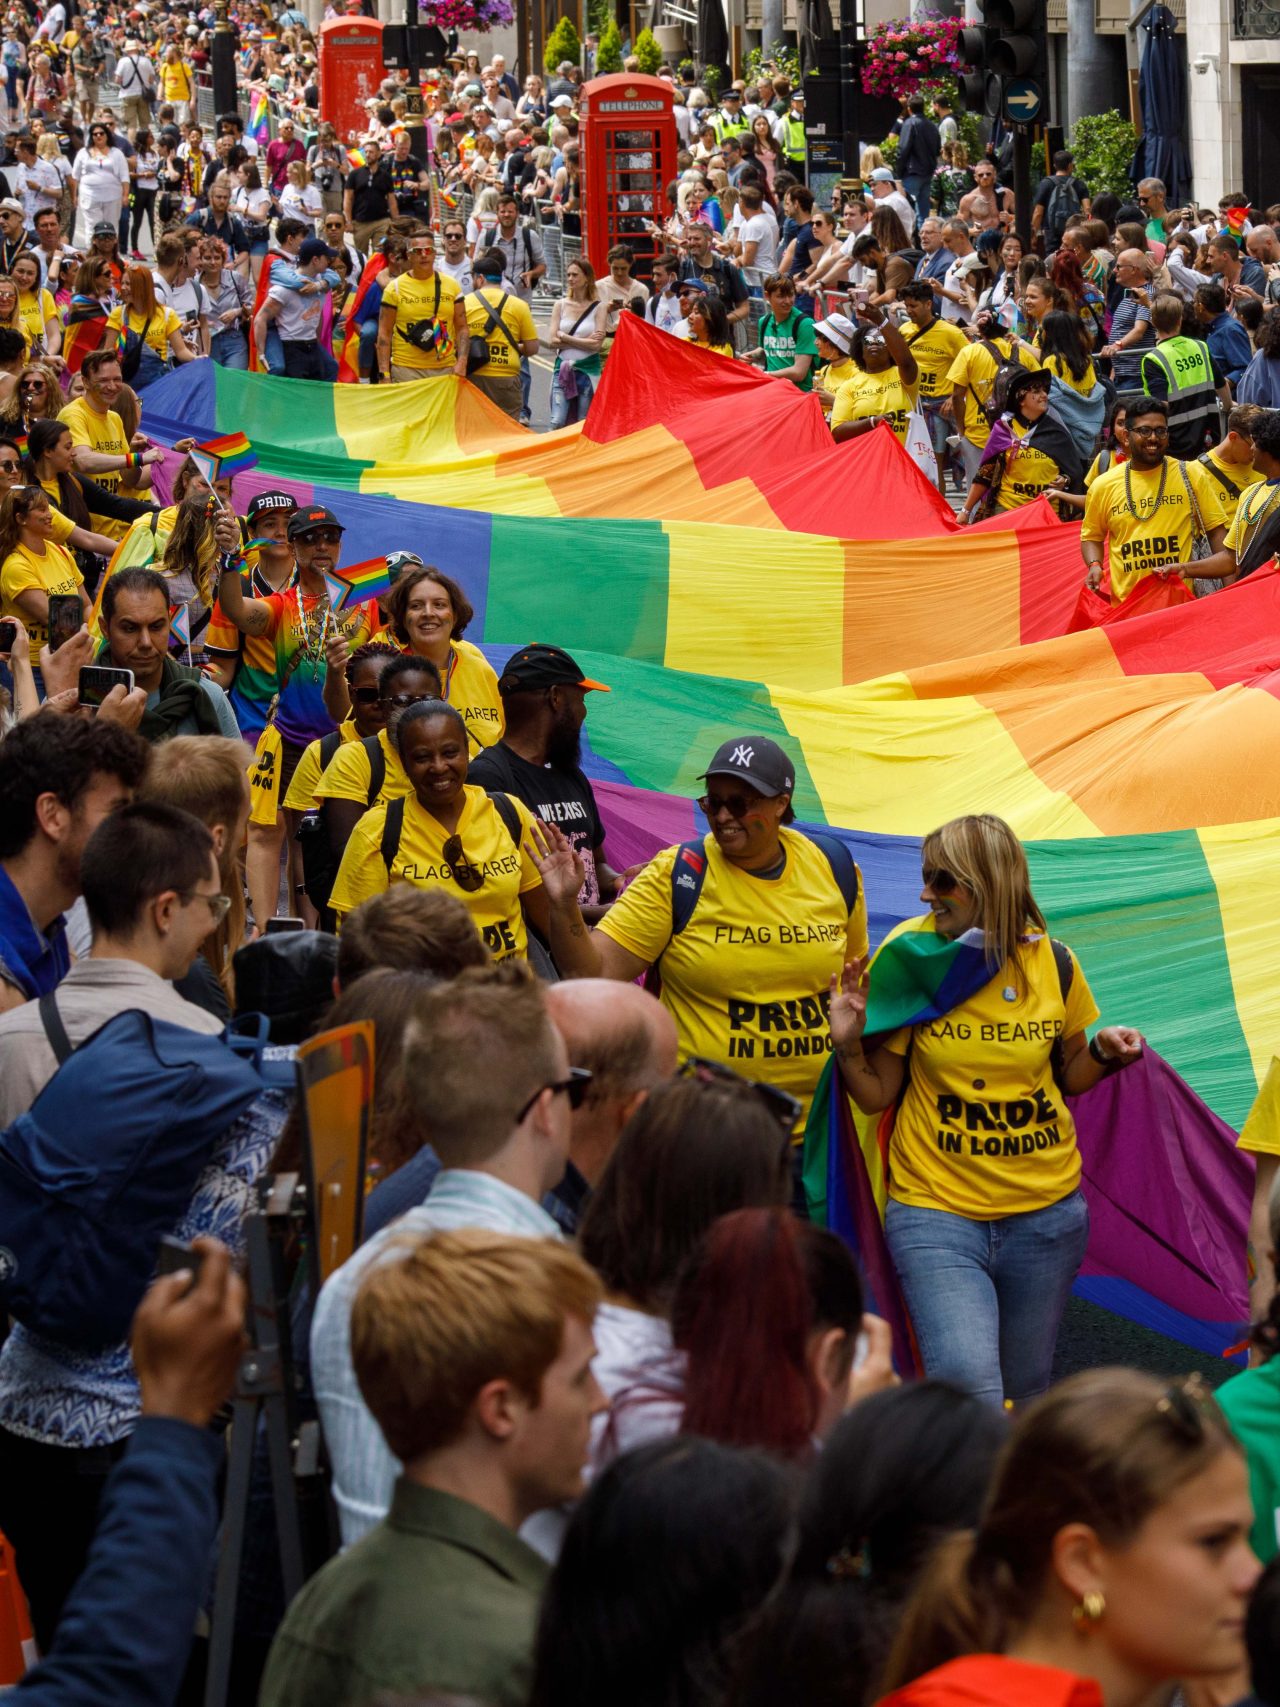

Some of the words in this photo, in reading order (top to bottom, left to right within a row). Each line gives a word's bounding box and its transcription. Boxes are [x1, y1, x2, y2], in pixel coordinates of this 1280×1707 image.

[603, 101, 661, 111] TELEPHONE
[400, 296, 420, 304] FLAG
[421, 295, 451, 304] BEAER
[1175, 353, 1204, 373] S398
[1014, 450, 1032, 459] LAG
[1121, 535, 1180, 561] PR!DE
[1123, 562, 1133, 573] IN
[1135, 555, 1180, 571] LONDON
[458, 706, 499, 722] EARER
[402, 864, 451, 881] FLAG
[714, 926, 771, 944] FLAG
[779, 925, 841, 944] BEARER
[920, 1021, 971, 1041] FLAG
[980, 1020, 1063, 1042] BEARER
[728, 1037, 754, 1058] IN
[762, 1035, 834, 1059] LONDO
[937, 1088, 1058, 1132] PR!DE
[937, 1130, 962, 1154] IN
[970, 1124, 1061, 1157] LONDON
